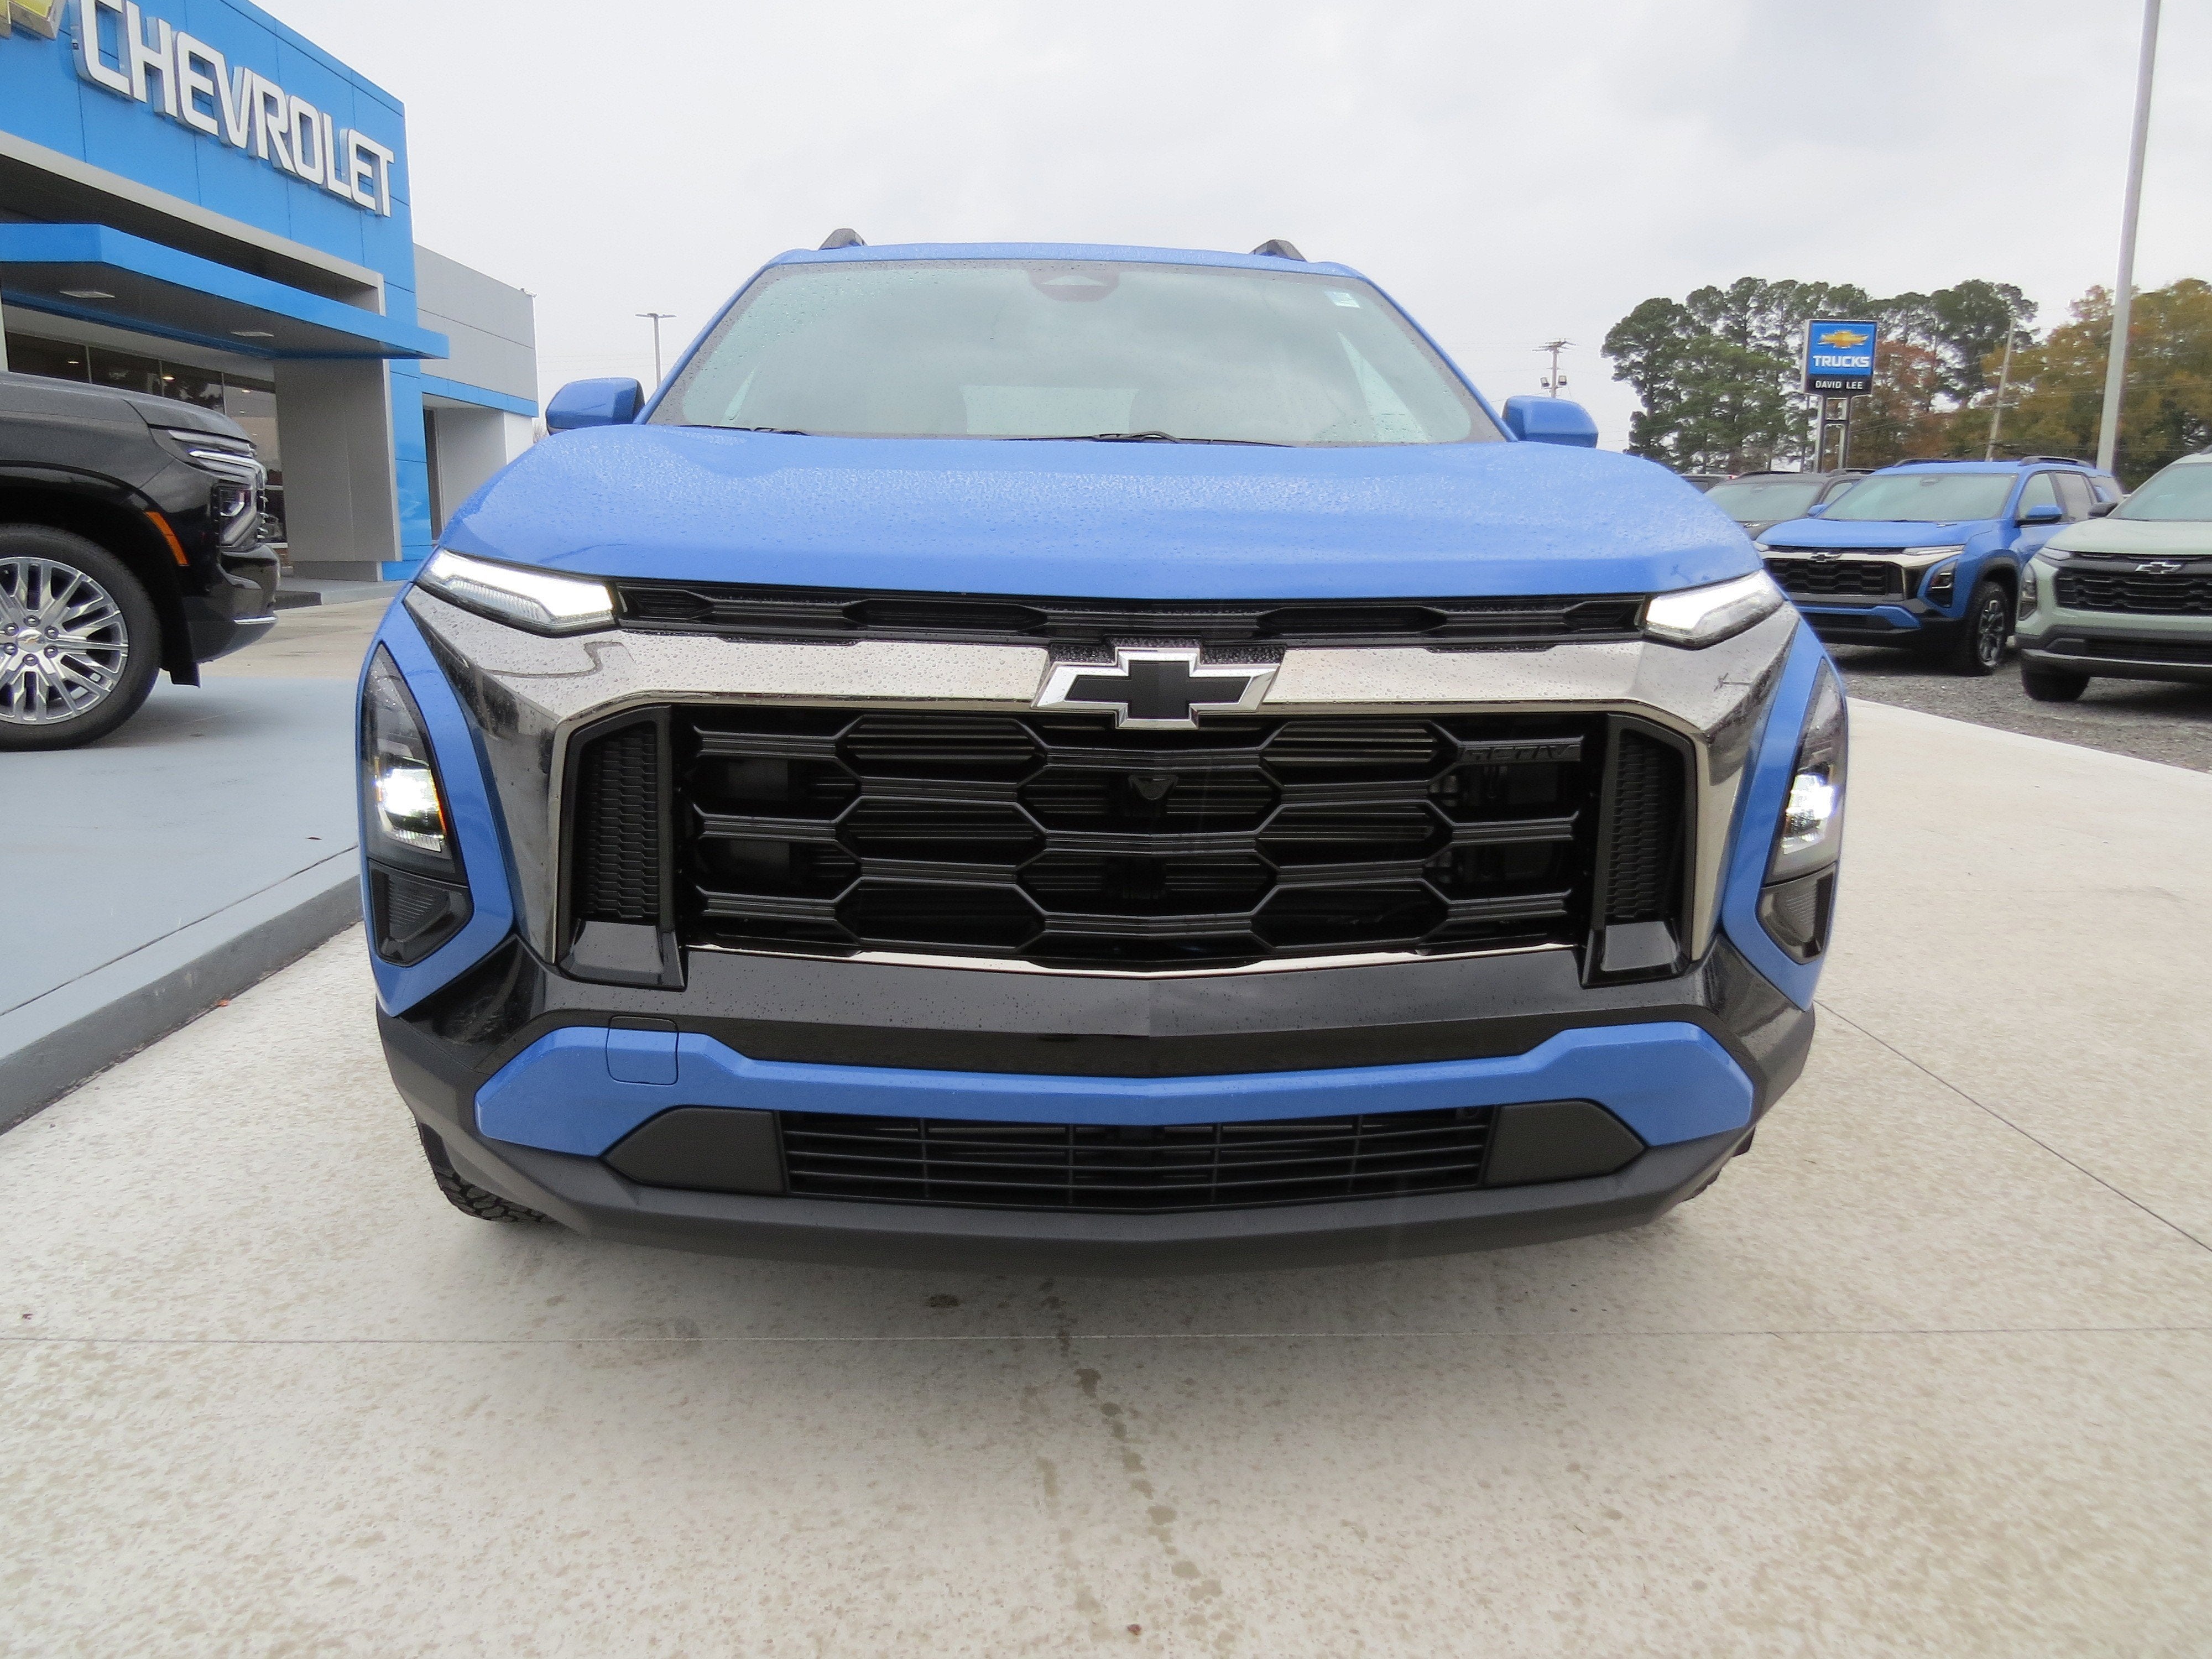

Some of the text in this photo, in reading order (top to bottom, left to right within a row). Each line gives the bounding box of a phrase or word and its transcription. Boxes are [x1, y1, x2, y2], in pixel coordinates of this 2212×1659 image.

[76, 0, 394, 218] CHEVROLET
[1813, 356, 1870, 368] TRUCKS
[1815, 380, 1863, 389] DAVID LEE
